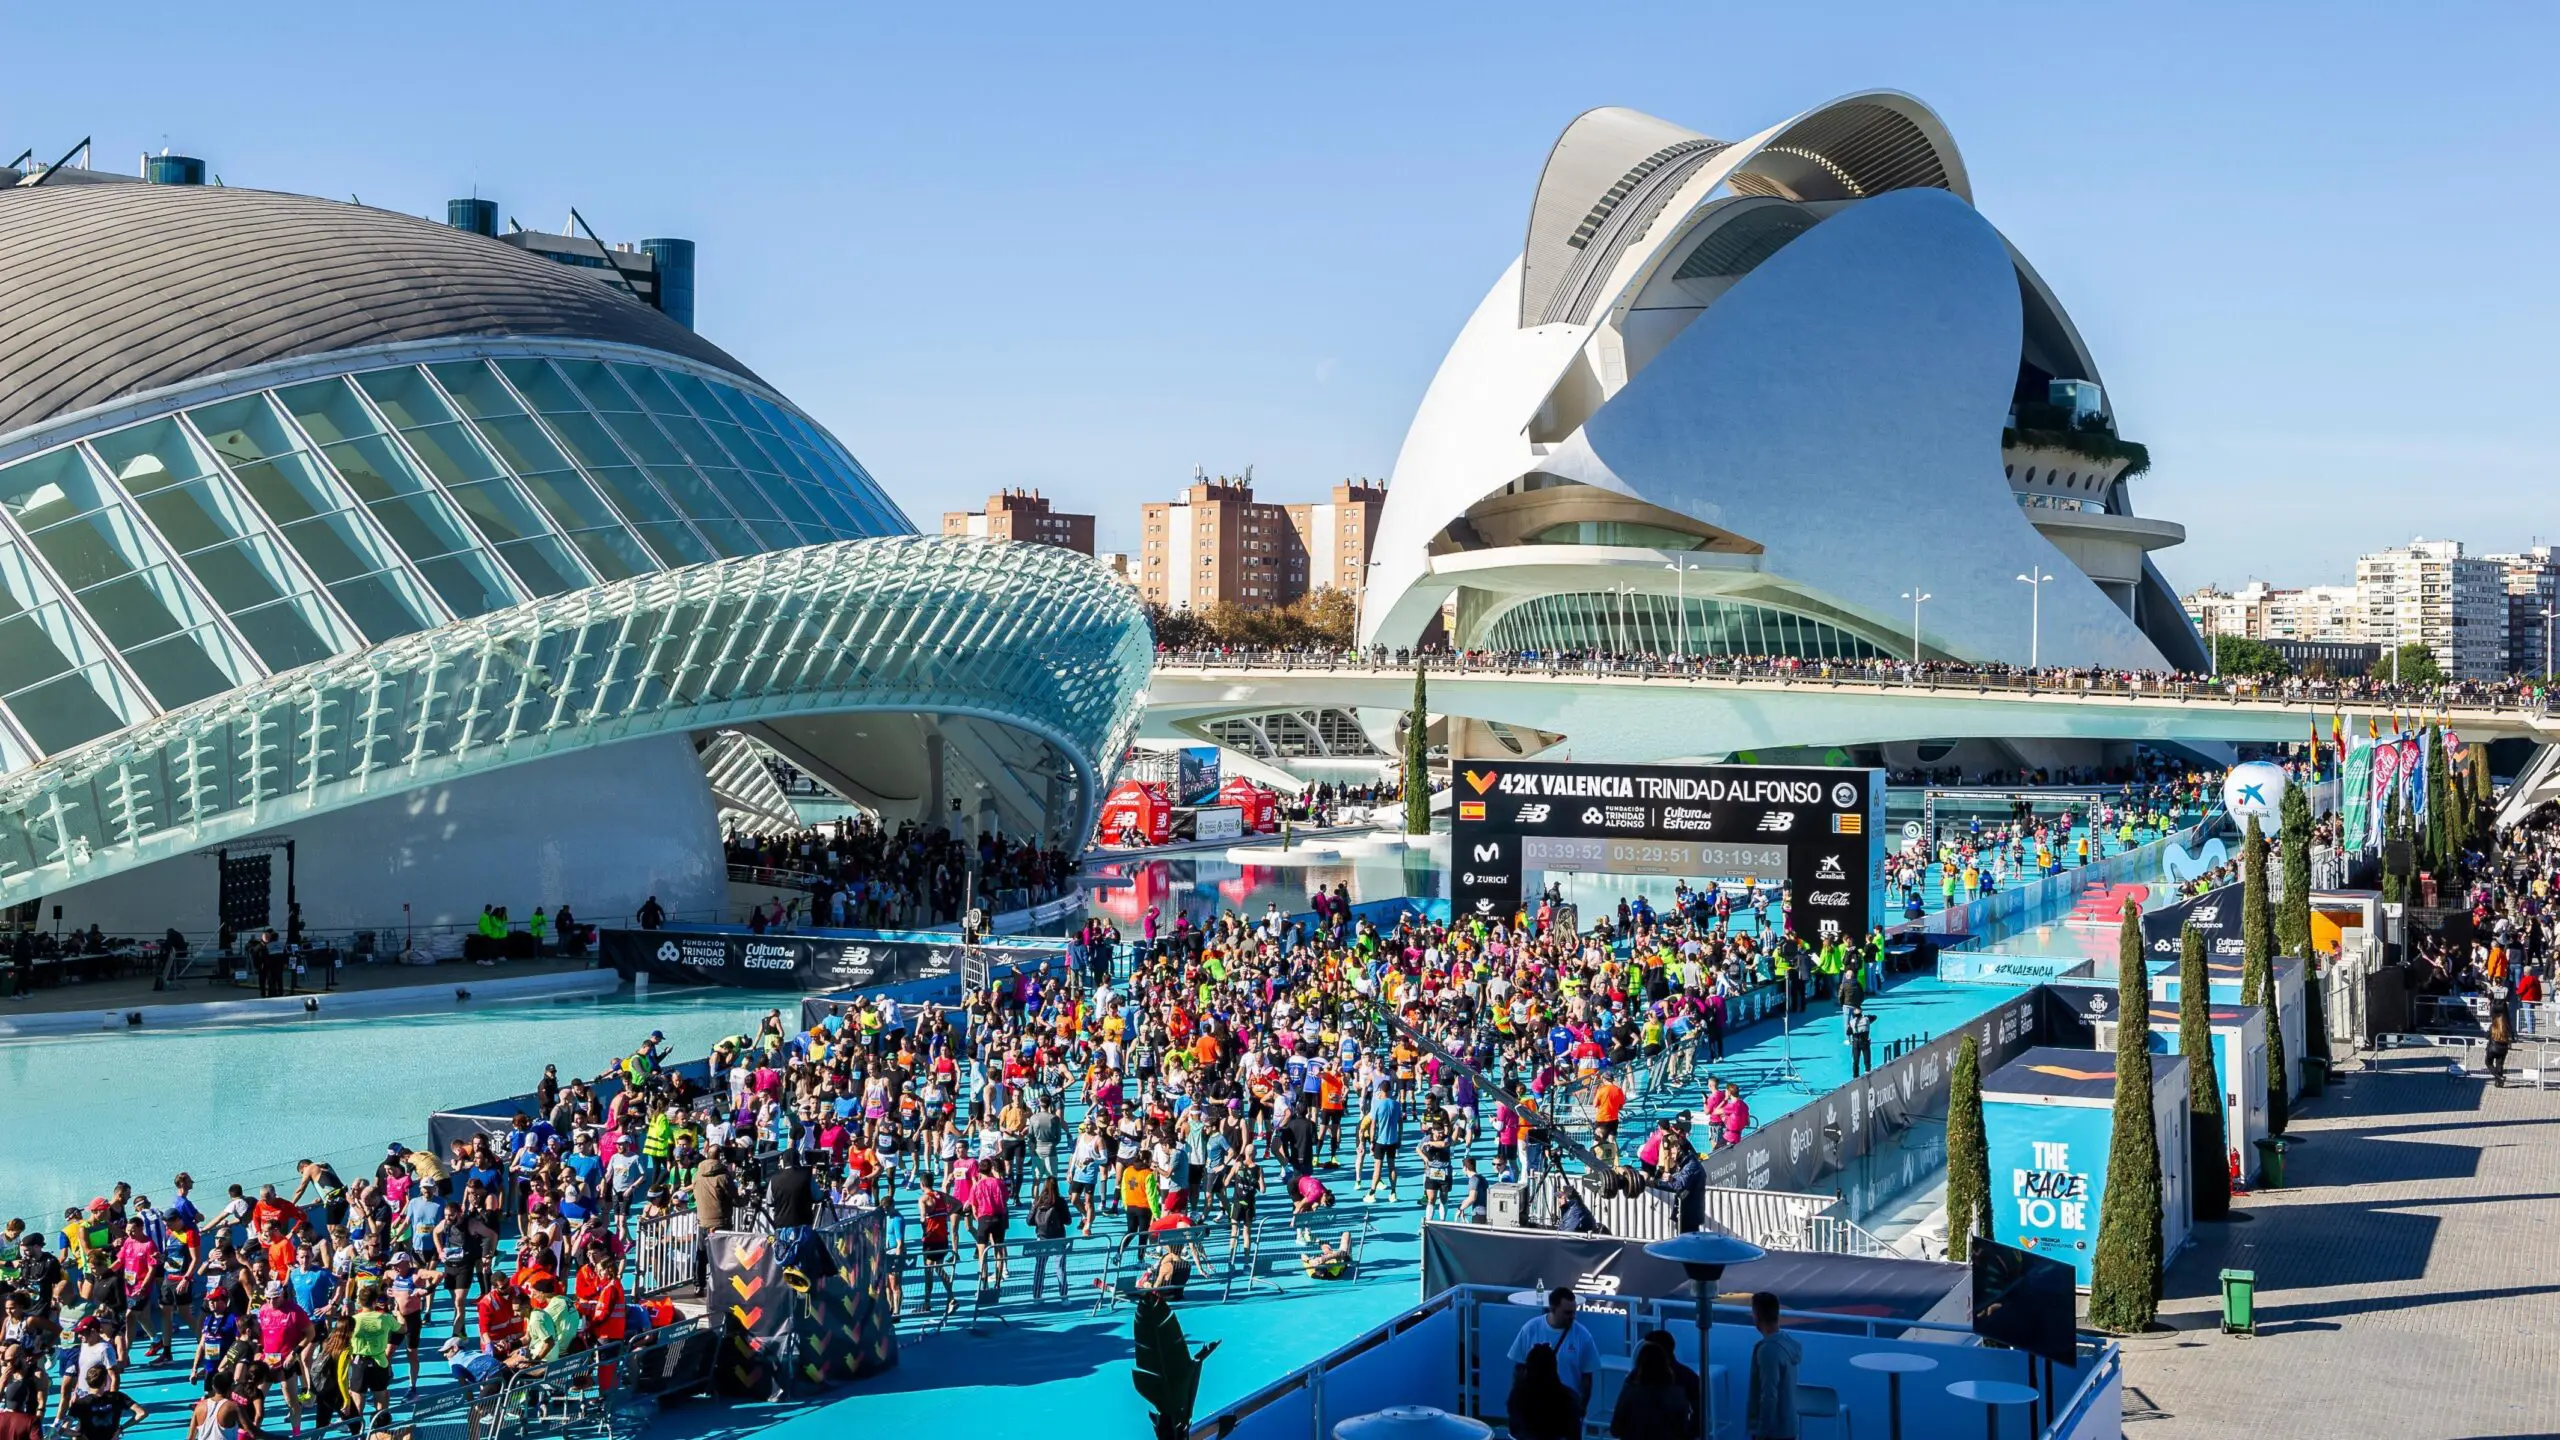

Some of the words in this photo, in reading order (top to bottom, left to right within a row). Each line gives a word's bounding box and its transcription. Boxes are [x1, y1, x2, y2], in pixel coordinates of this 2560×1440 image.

[1499, 773, 1539, 795] 42K
[1542, 774, 1634, 798] VALENCIA
[1635, 777, 1725, 800] TRINIDAD
[1727, 780, 1822, 804] ALFONSO
[1605, 805, 1645, 813] FUNDACIÓN
[1664, 807, 1702, 819] Cultura
[1605, 812, 1645, 821] TRINIDAD
[1605, 819, 1645, 829] ALFONSO
[1663, 818, 1712, 830] Esfuerzo
[1527, 842, 1603, 860] 03:39:52
[1613, 846, 1690, 864] 03:29:51
[1702, 849, 1782, 867] 03:19:43
[1476, 875, 1507, 884] ZURICH
[1816, 872, 1846, 880] CaixaBank
[2216, 938, 2245, 946] Cultura
[682, 946, 726, 957] TRINIDAD
[746, 943, 785, 957] Cultura
[784, 950, 795, 958] del
[2216, 946, 2247, 954] Esfuerz
[682, 956, 725, 966] ALFONSO
[744, 956, 794, 970] Esfuerzo
[832, 966, 846, 974] new
[846, 966, 874, 976] balance
[1876, 1082, 1897, 1108] ZURICH
[1800, 1120, 1813, 1155] edp
[2032, 1141, 2069, 1171] THE
[1711, 1161, 1737, 1181] FUNDACIÓN
[2024, 1172, 2085, 1199] RACE
[2017, 1199, 2056, 1228] TO
[2061, 1202, 2086, 1231] BE
